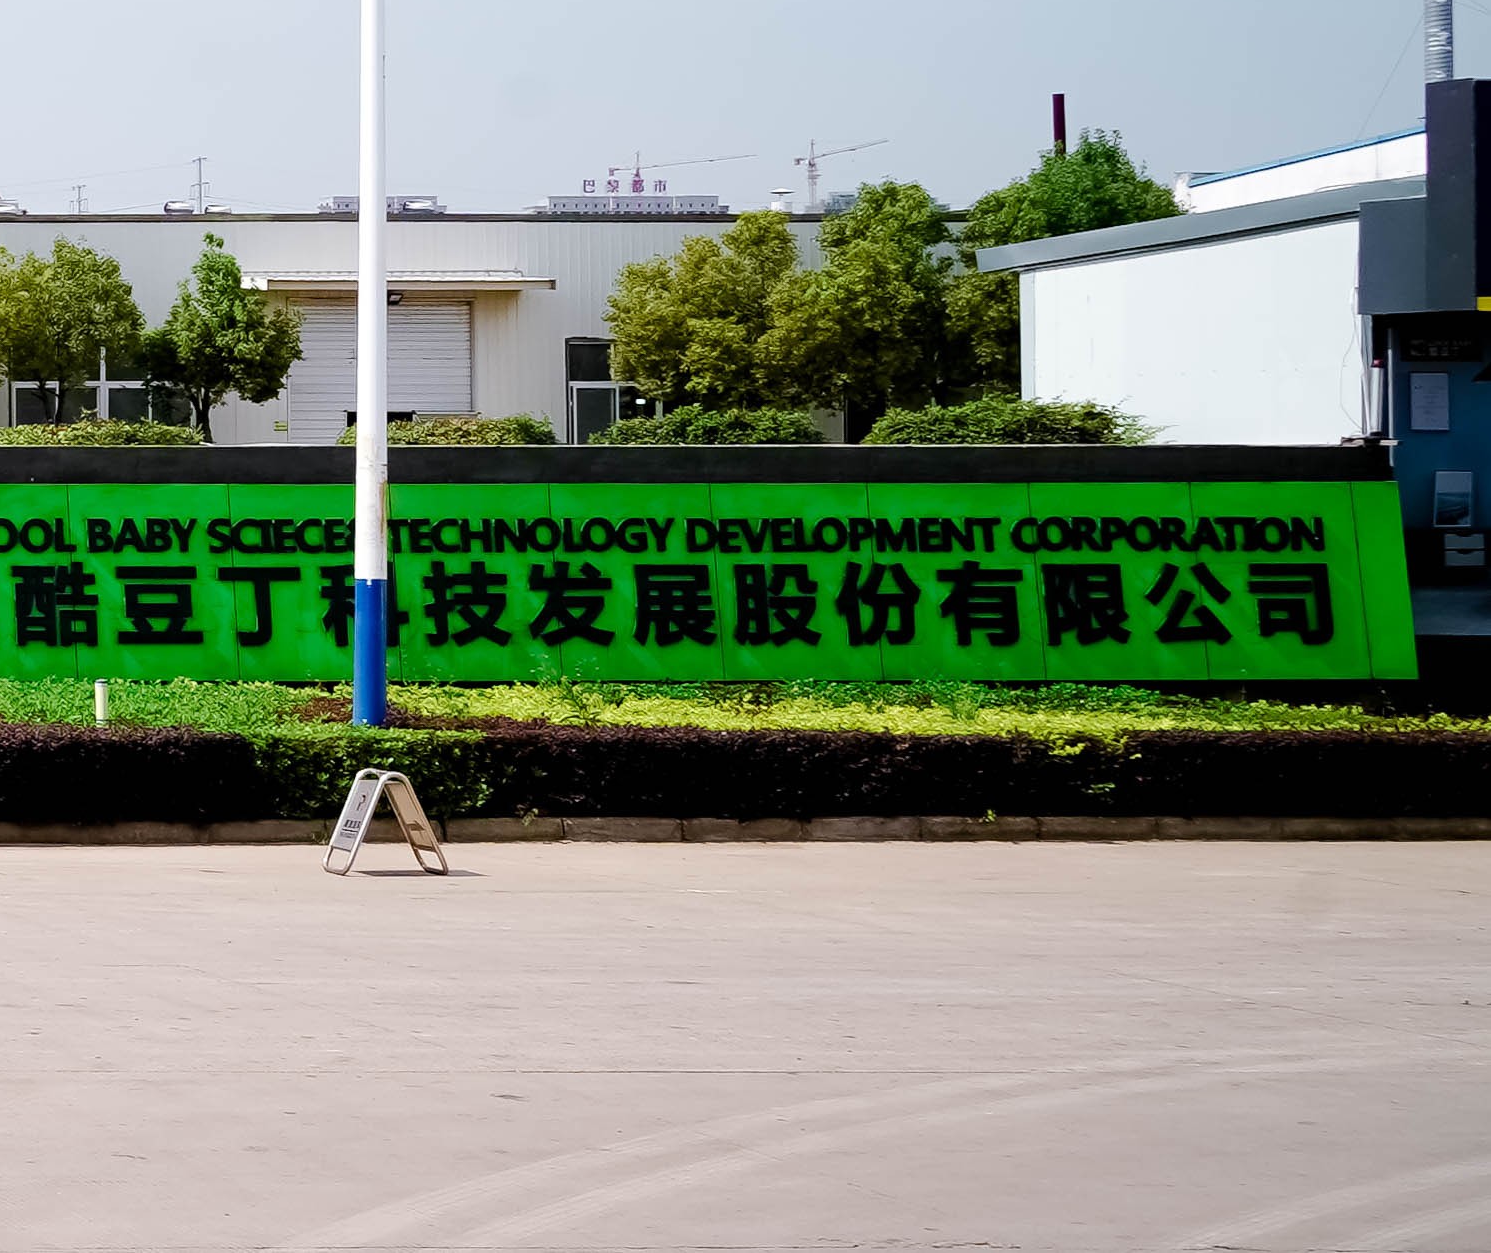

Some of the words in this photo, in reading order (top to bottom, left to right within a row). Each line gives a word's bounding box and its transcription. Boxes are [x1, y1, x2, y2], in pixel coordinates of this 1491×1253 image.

[583, 178, 667, 193] 巴黎都市
[87, 517, 198, 554] BABY
[206, 517, 356, 554] SCIECE
[387, 518, 674, 553] TECHNOLOGY
[684, 517, 997, 554] DEVELOPMENT
[1009, 516, 1326, 554] CORPORATION
